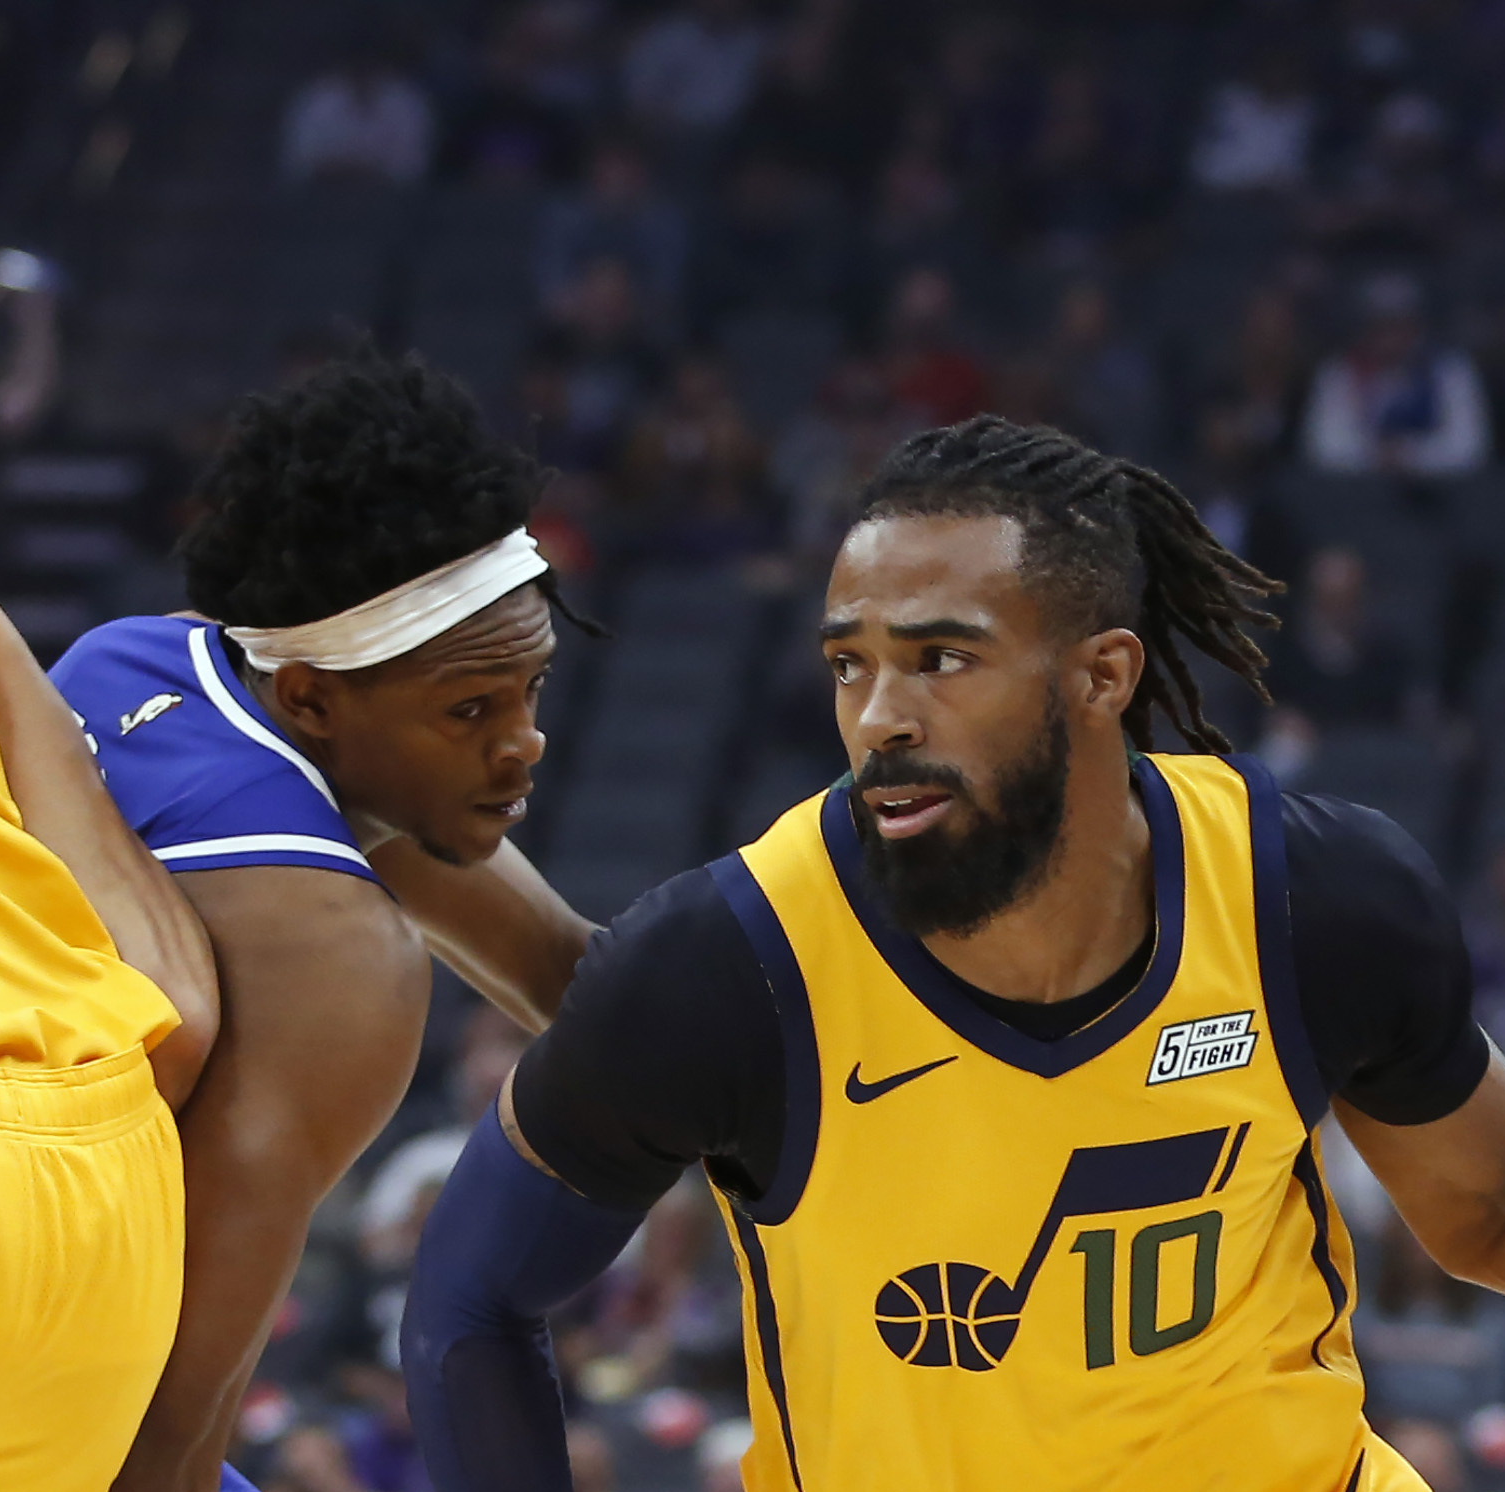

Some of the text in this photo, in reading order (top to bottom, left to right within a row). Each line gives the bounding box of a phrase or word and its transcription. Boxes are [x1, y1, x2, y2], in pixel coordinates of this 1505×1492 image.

[1196, 1019, 1244, 1039] FOR THE
[1157, 1030, 1185, 1076] 5
[1187, 1040, 1248, 1070] FIGHT
[1069, 1209, 1223, 1372] 10
